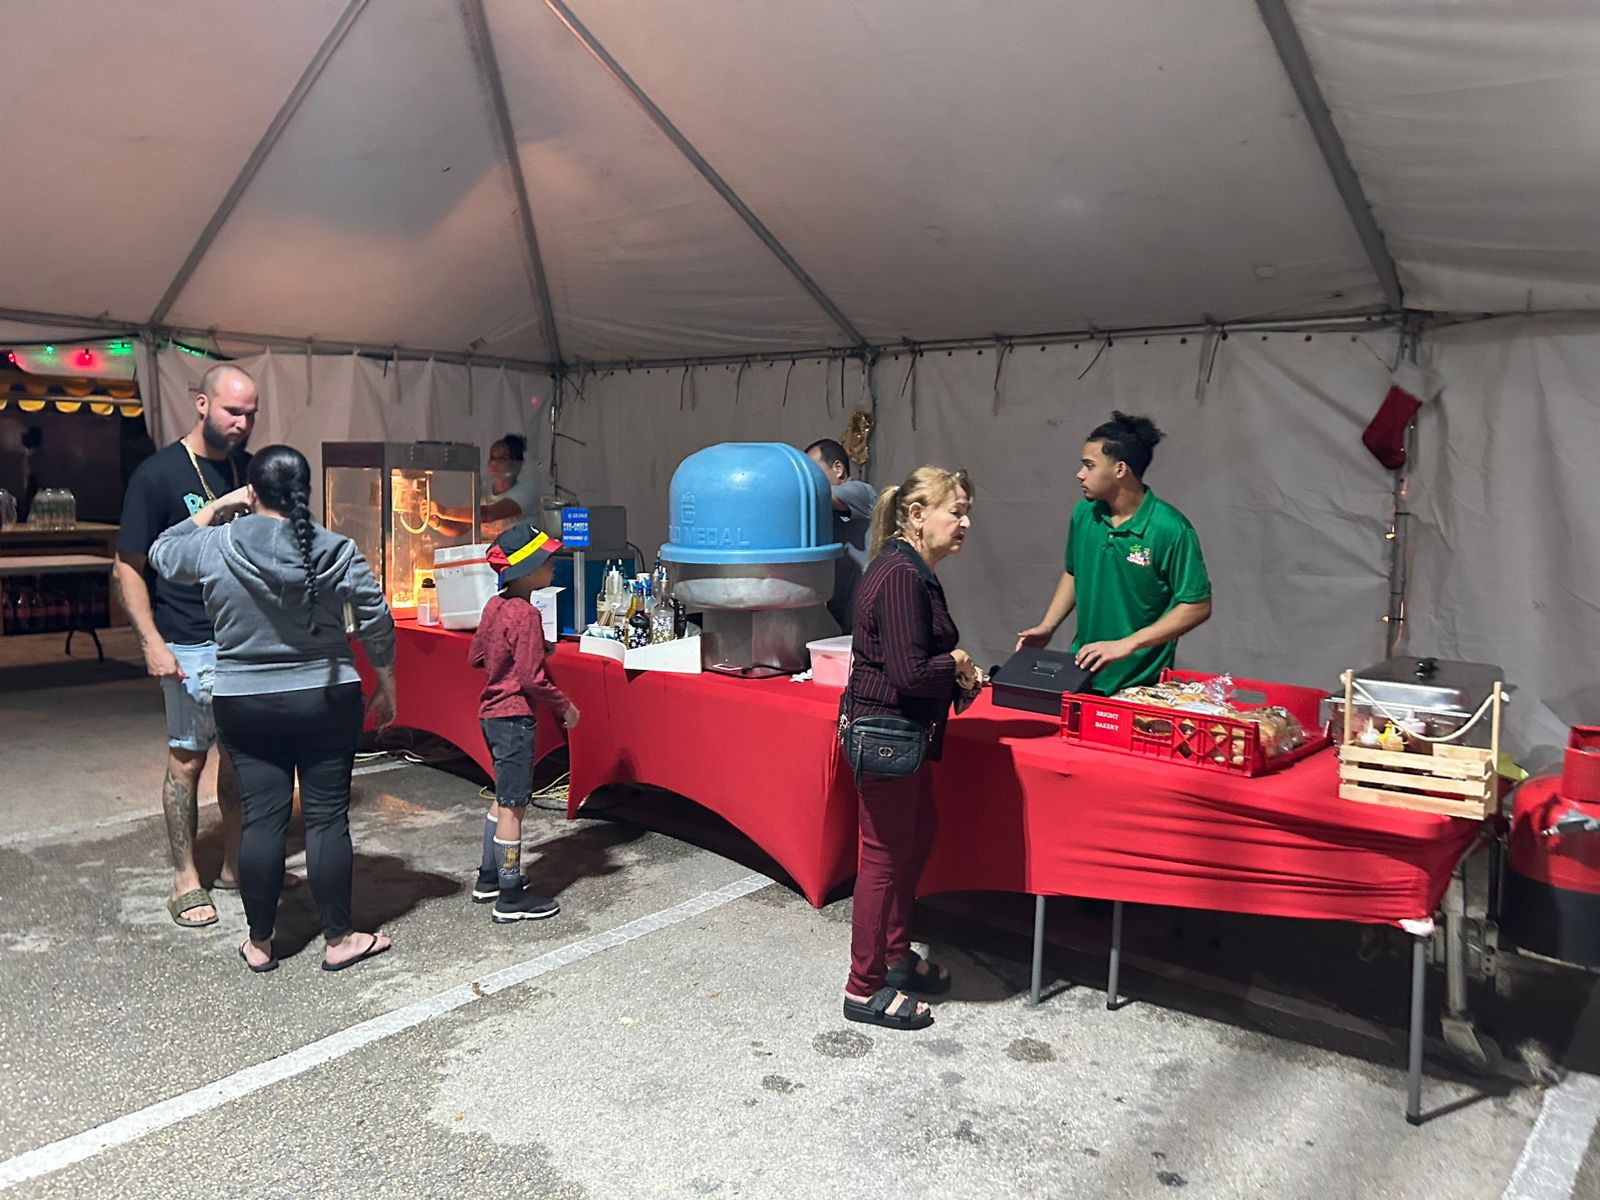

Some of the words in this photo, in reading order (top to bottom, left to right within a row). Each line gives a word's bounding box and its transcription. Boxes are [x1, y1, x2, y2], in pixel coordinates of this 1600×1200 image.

[684, 526, 750, 546] MEDAL
[1095, 710, 1119, 720] BRIGHT
[1095, 721, 1119, 731] BAKERY
